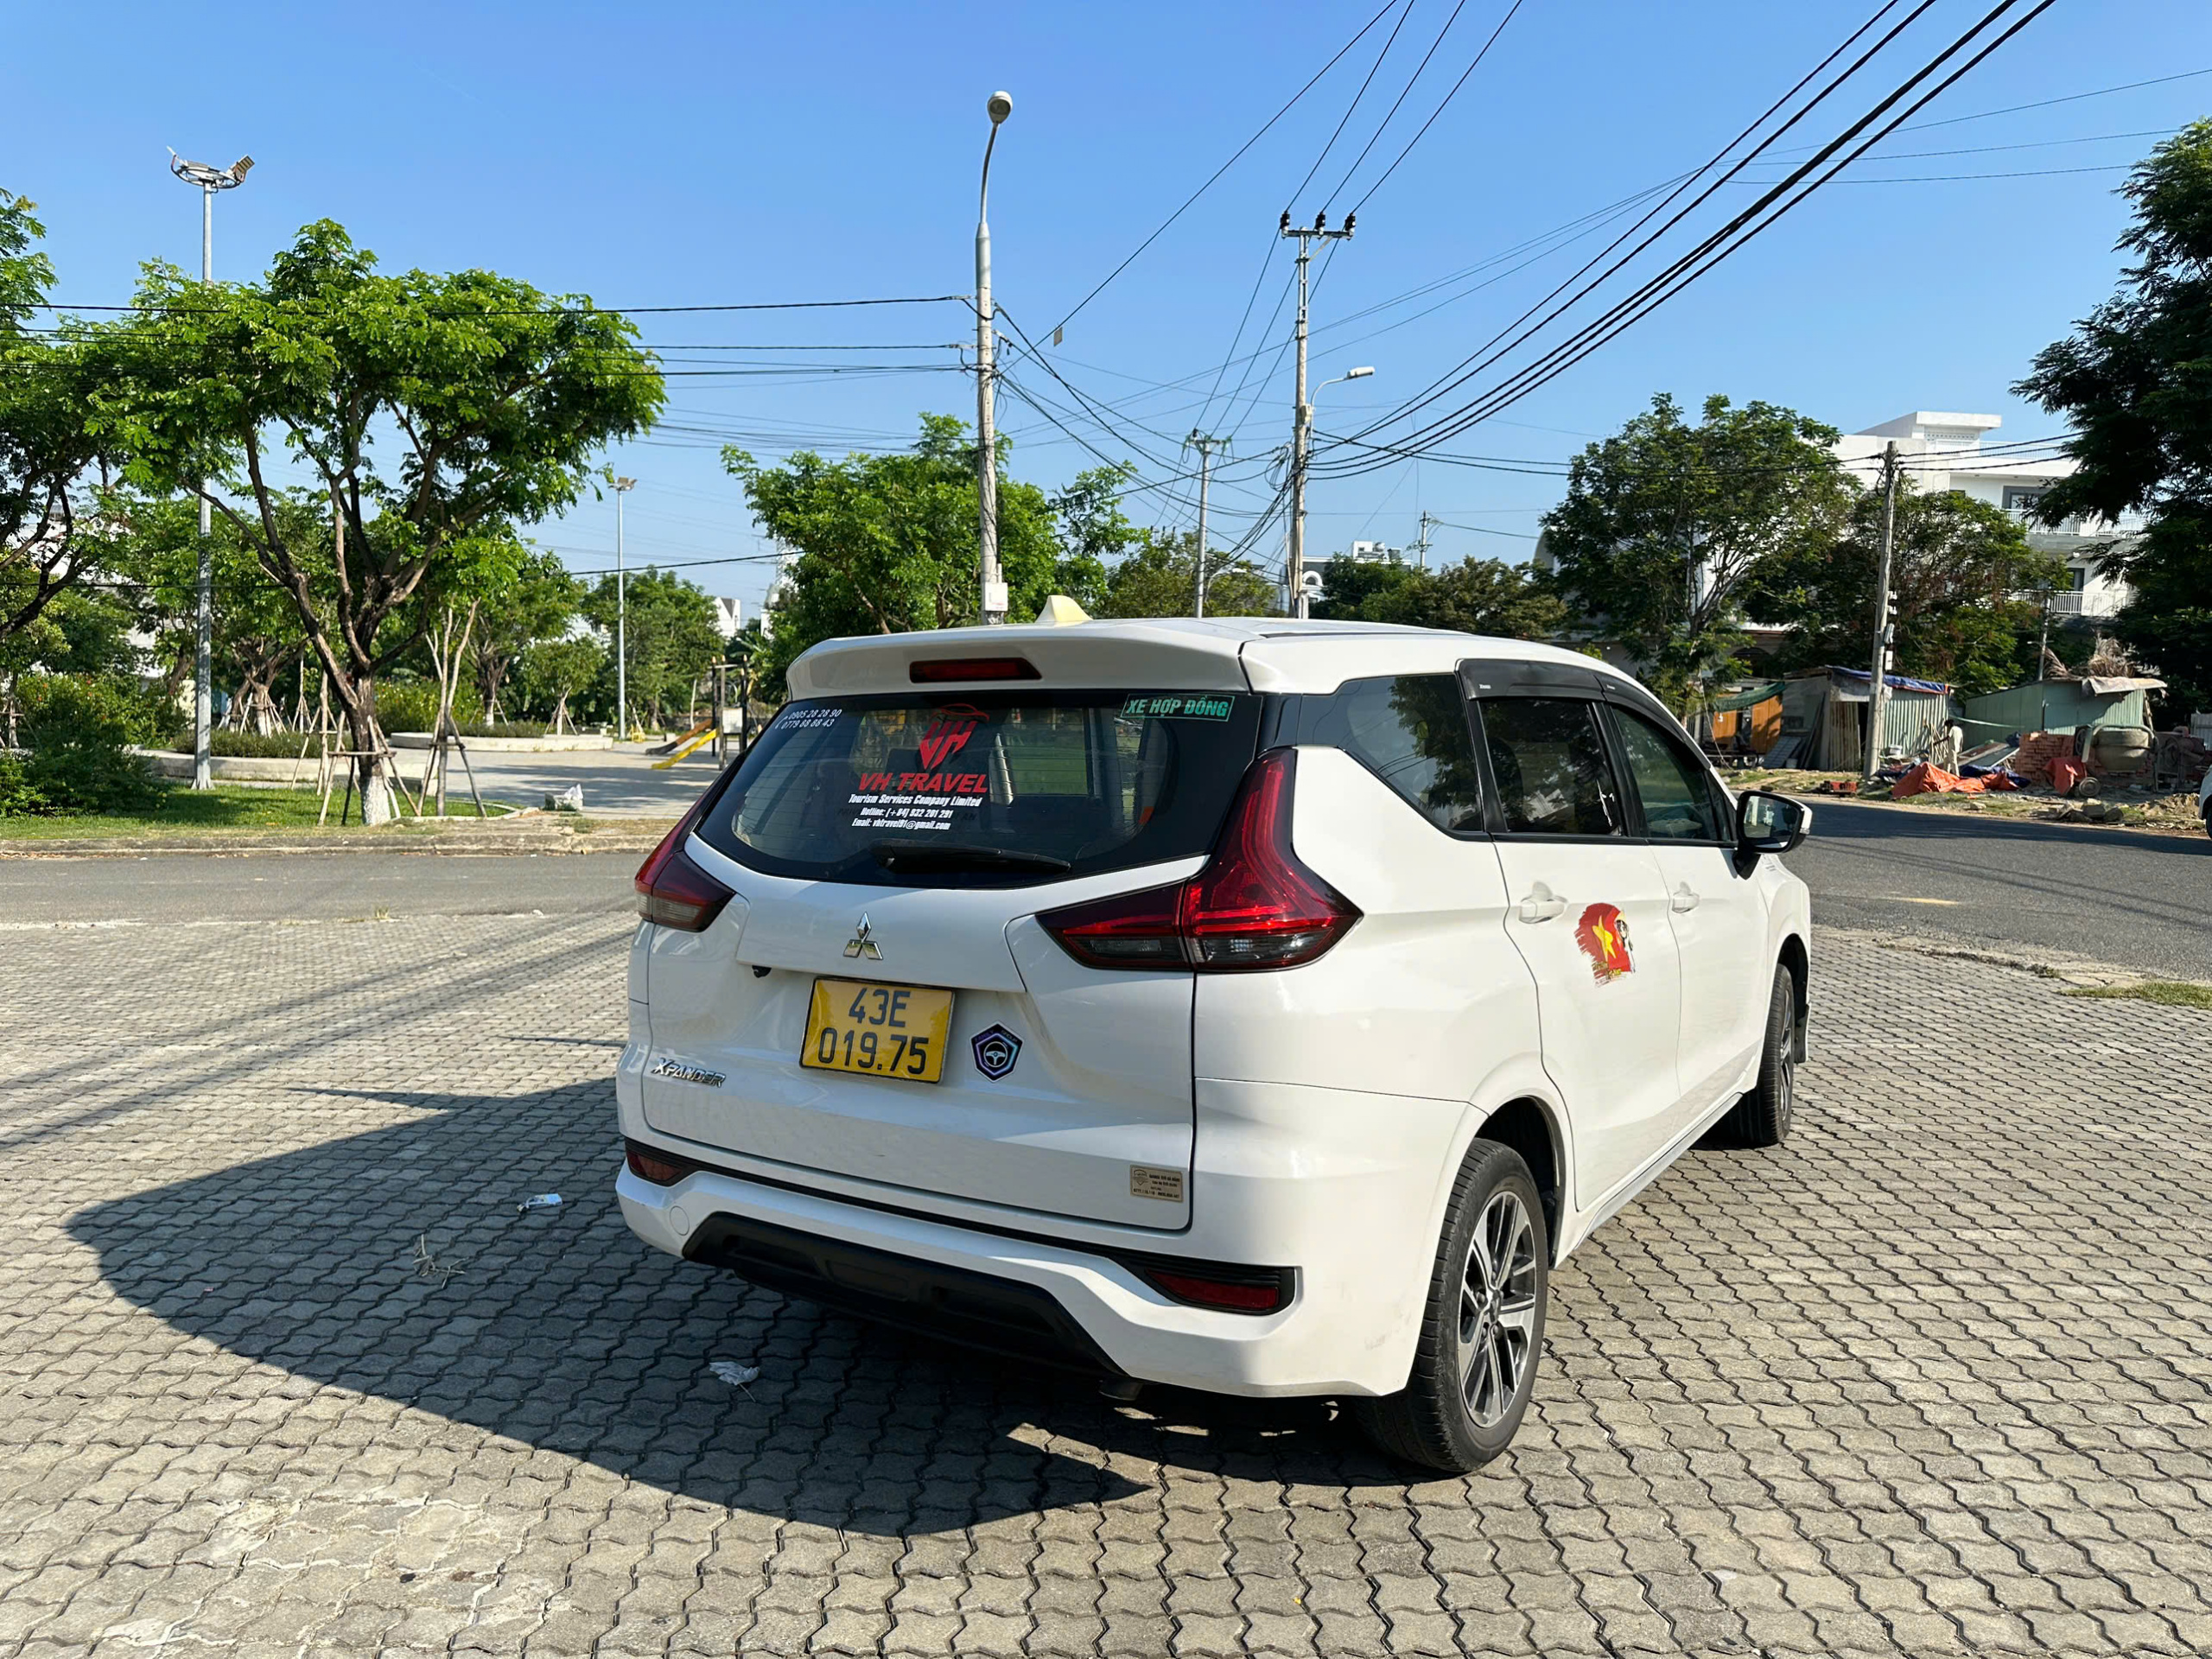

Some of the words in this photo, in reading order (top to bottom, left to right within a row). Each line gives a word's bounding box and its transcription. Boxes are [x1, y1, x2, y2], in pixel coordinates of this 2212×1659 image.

[1126, 699, 1147, 714] XE
[1149, 697, 1181, 717] HỢP
[1184, 695, 1229, 716] ĐỒNG
[859, 772, 893, 791] VH
[897, 772, 988, 793] TRAVEL
[849, 794, 879, 803] Tourism
[879, 794, 914, 804] Services
[913, 795, 951, 807] Company
[950, 796, 982, 806] Limited
[849, 988, 911, 1027] 43E
[817, 1027, 930, 1075] 019.75
[651, 1057, 727, 1089] XPANDER
